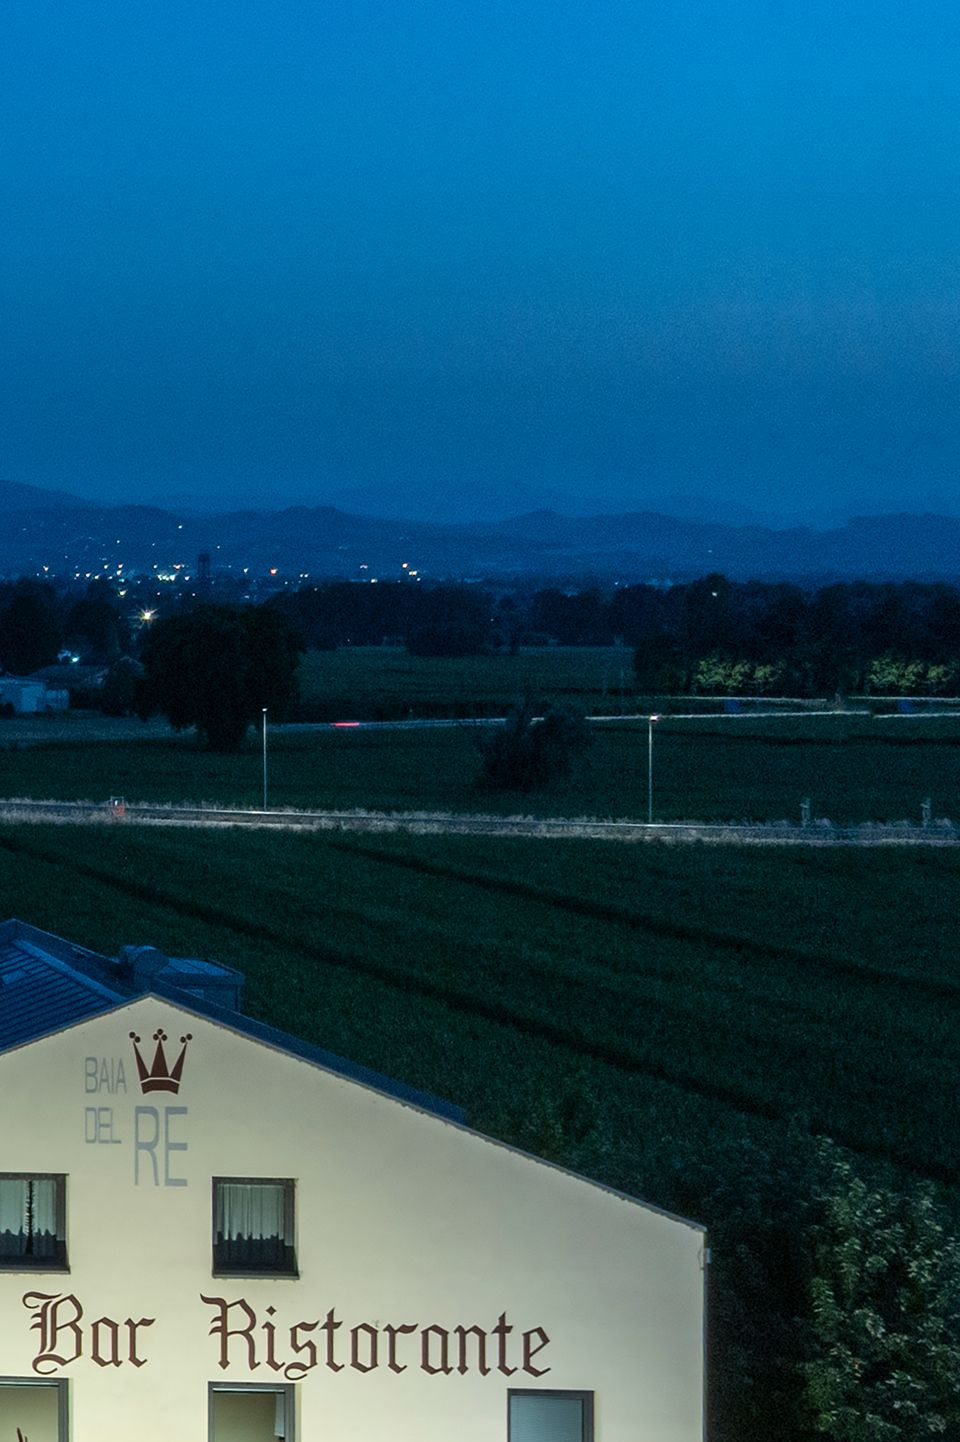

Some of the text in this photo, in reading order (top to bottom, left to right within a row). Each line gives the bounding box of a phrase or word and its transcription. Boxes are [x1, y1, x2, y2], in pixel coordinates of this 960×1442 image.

[84, 1056, 128, 1095] BAIA
[84, 1104, 189, 1188] DEL RE
[21, 1290, 157, 1376] Bar
[199, 1292, 552, 1381] Ristorante
